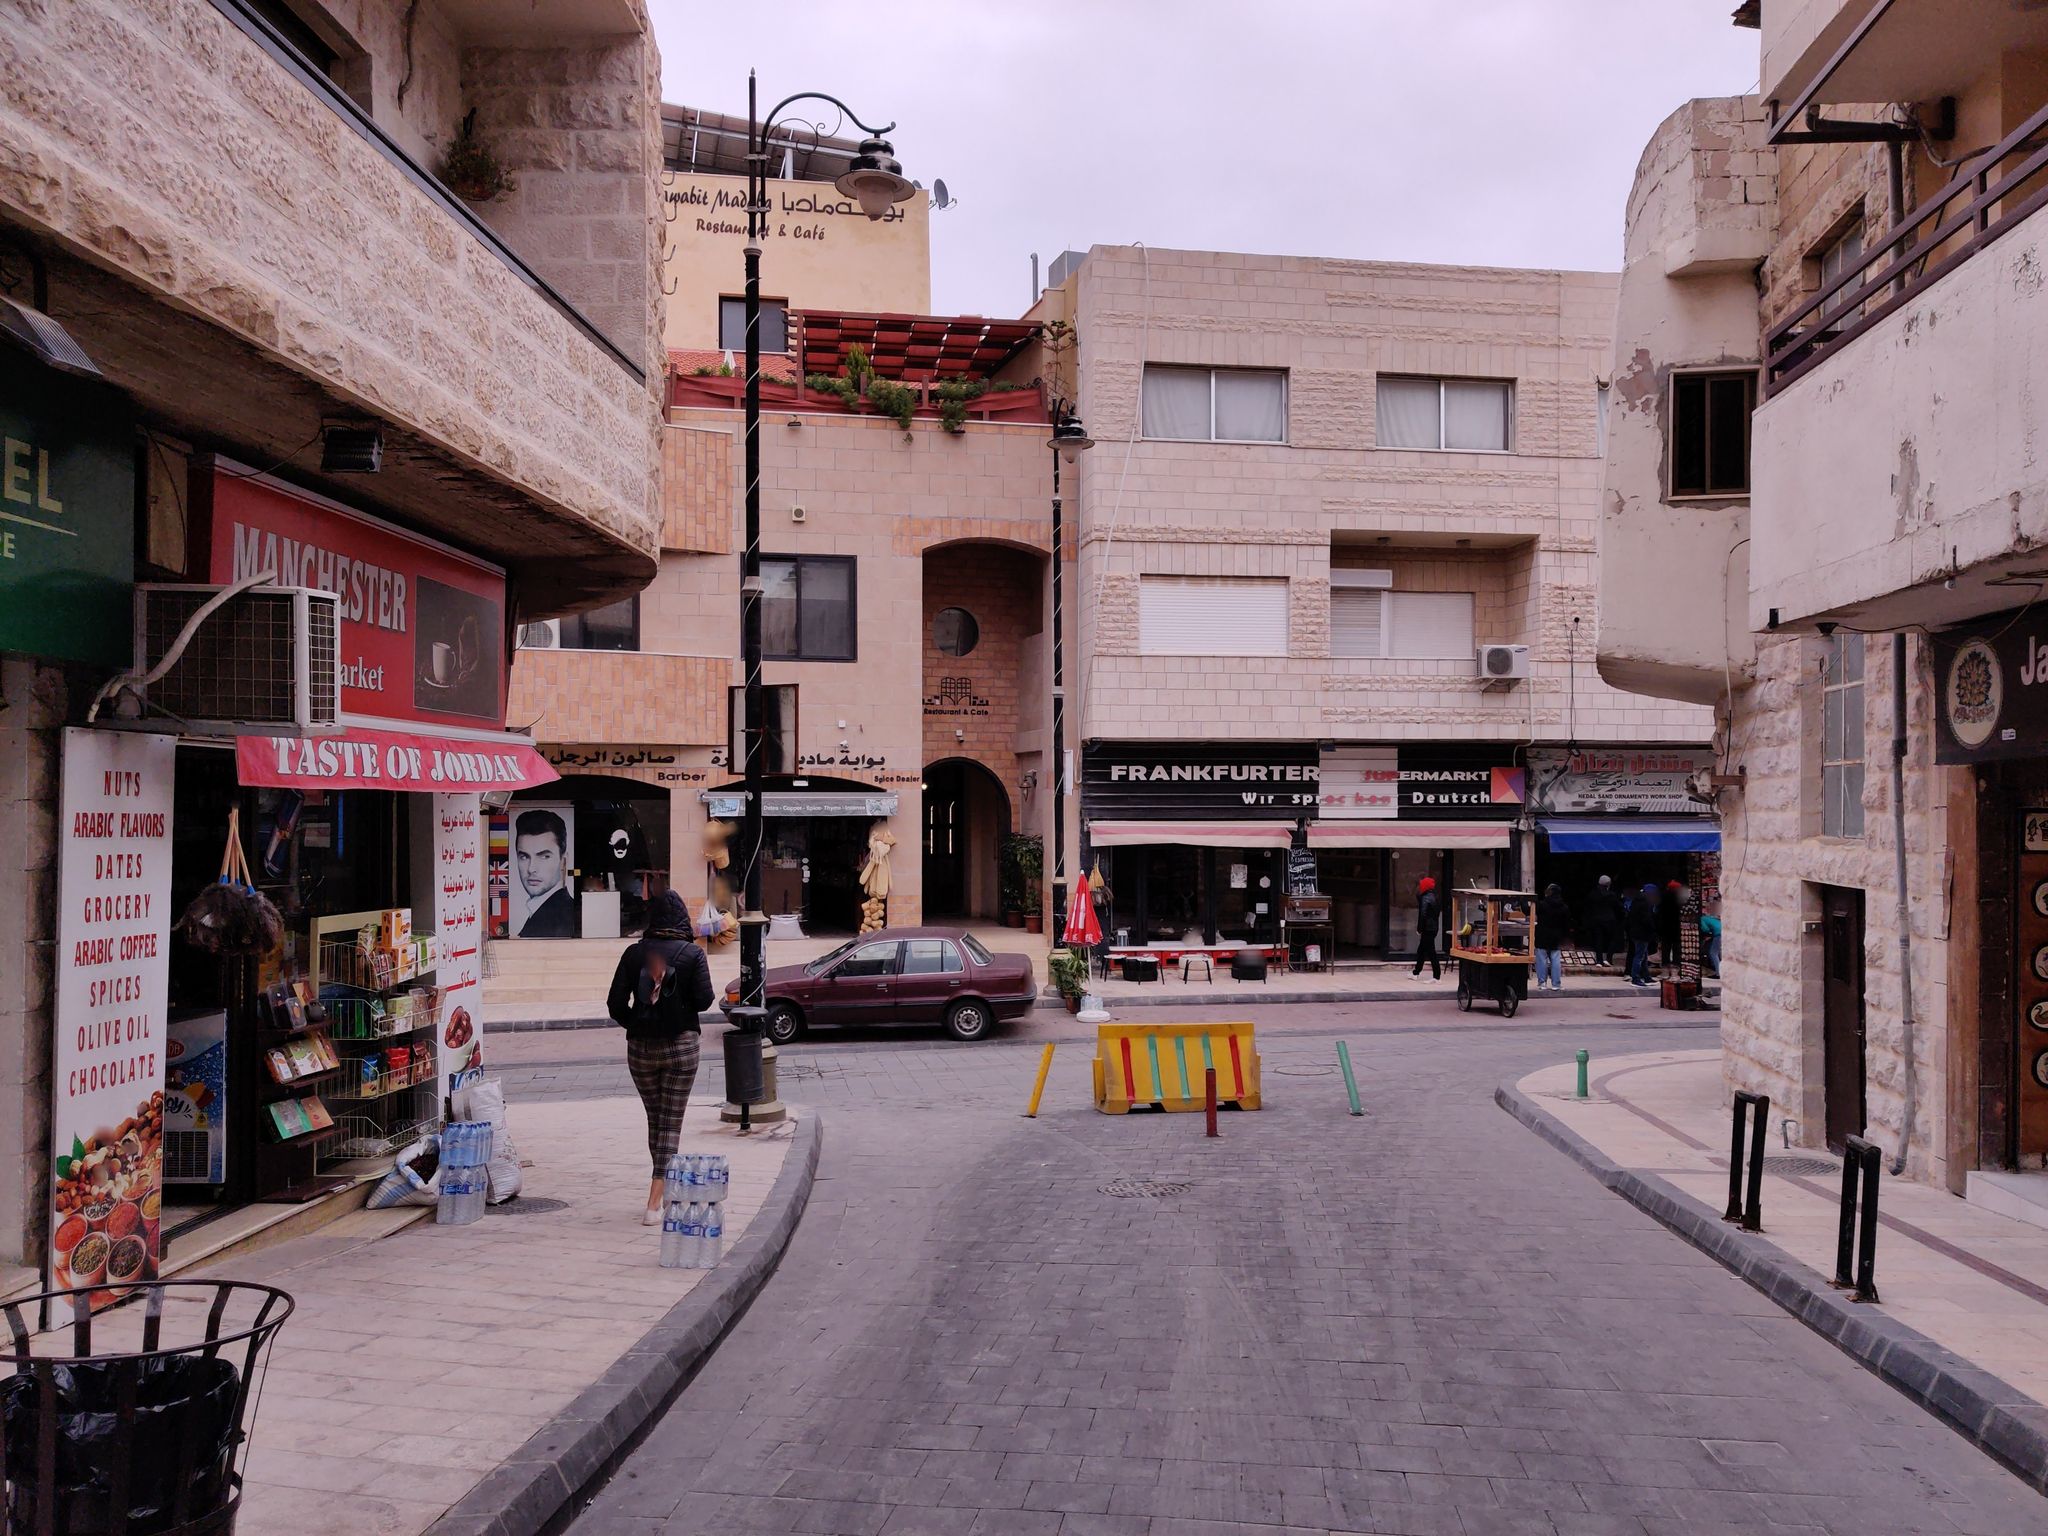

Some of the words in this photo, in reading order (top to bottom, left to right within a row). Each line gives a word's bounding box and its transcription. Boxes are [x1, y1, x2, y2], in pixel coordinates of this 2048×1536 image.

[710, 188, 771, 213] Madba
[696, 218, 769, 237] Restaurnt
[778, 224, 786, 236] &
[794, 224, 825, 240] Café
[4, 436, 62, 513] EL
[0, 531, 15, 559] E
[233, 522, 406, 632] MANCHESTER
[341, 657, 384, 691] arket
[2020, 636, 2048, 686] Ja
[272, 736, 380, 777] TASTE
[386, 745, 421, 780] OF
[430, 749, 526, 782] JORDAN
[551, 750, 607, 766] الرجل
[611, 750, 675, 767] صالون
[799, 752, 835, 770] مادب
[839, 749, 886, 770] بوابة
[104, 771, 140, 797] NUTS
[657, 772, 707, 781] Barber
[874, 775, 894, 784] Spice
[896, 775, 920, 783] Dealer
[1111, 765, 1320, 781] FRANKFURTER
[1242, 792, 1275, 805] Wir
[1412, 791, 1490, 804] Deutsch
[73, 812, 114, 838] ARABIC
[120, 813, 165, 838] FLAVORS
[95, 853, 142, 880] DATES
[84, 893, 151, 923] GROCERY
[74, 937, 114, 967] ARABIC
[120, 933, 157, 961] COFFEE
[90, 975, 141, 1008] SPICES
[78, 1019, 121, 1052] OLIVE
[127, 1014, 149, 1042] OIL
[69, 1053, 155, 1097] CHOCOLATE
